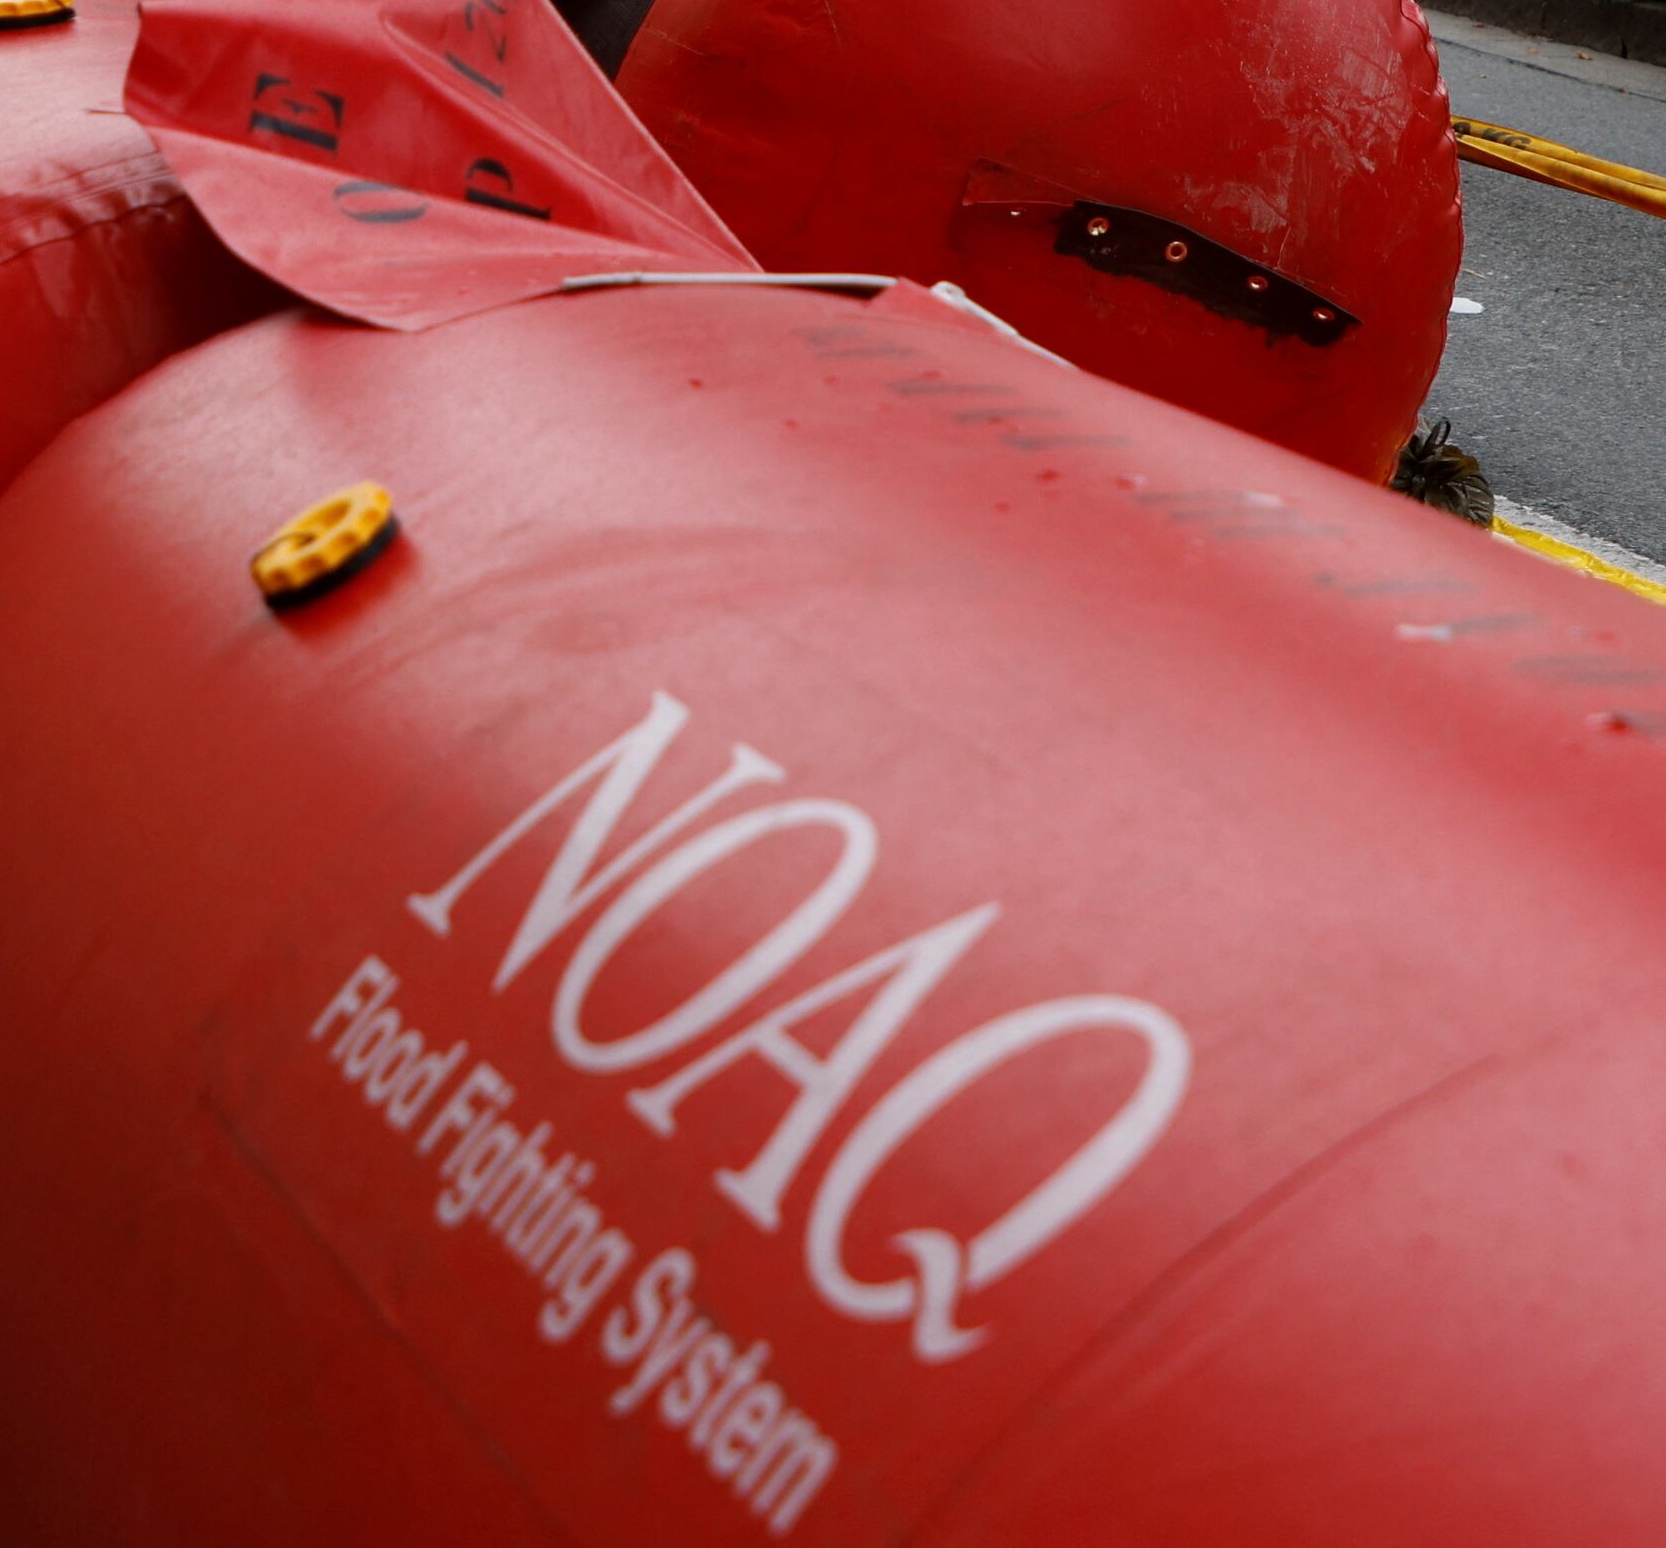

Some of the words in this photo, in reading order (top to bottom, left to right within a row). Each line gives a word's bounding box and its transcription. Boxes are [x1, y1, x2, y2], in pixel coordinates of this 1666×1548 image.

[310, 954, 467, 1131] Flood
[417, 1058, 632, 1343] Fighting
[600, 1246, 840, 1534] System
[407, 691, 1192, 1363] NOAQ
